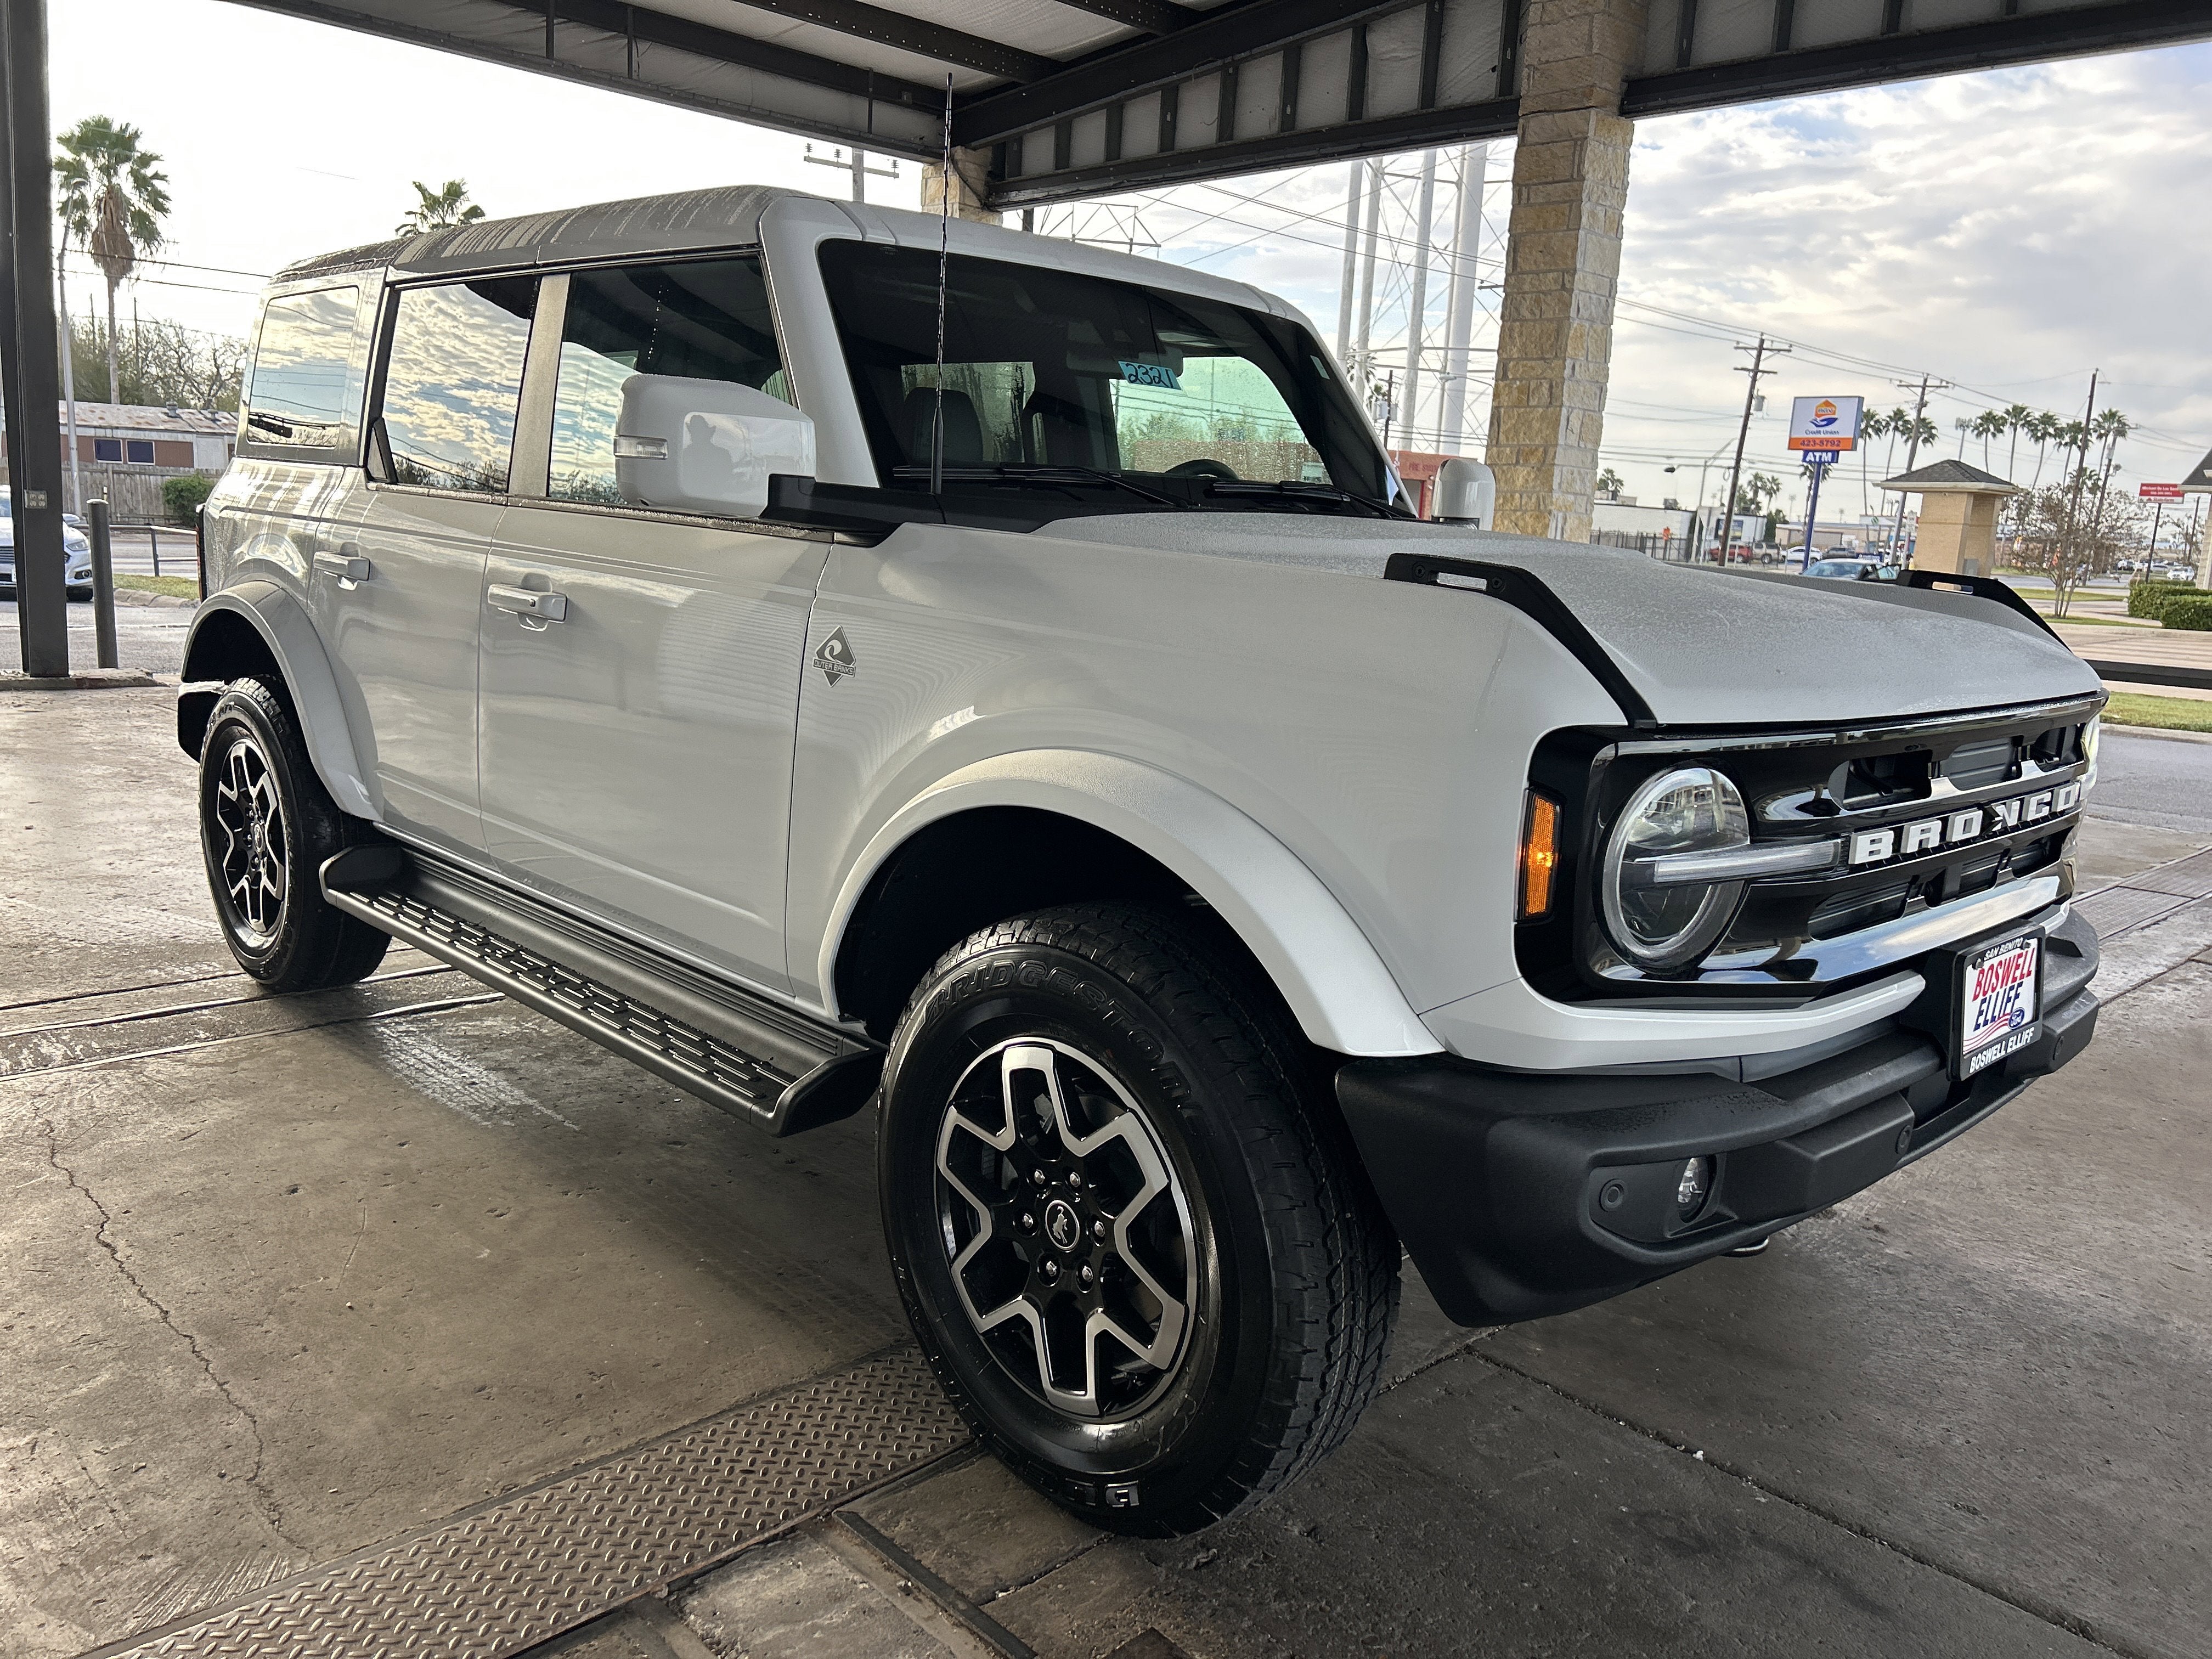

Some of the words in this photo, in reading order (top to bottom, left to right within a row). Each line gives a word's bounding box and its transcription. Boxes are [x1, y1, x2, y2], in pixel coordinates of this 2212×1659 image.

[1125, 363, 1175, 388] 2321
[1805, 452, 1832, 462] ATM
[814, 659, 833, 670] OUTER
[833, 664, 854, 675] BANKS
[1849, 783, 2079, 865] BRONCO
[1983, 946, 2000, 961] SAN
[2000, 937, 2023, 956] BENITO
[1972, 947, 2035, 1002] BOSWELL
[1973, 981, 2024, 1032] ELLIFF
[1969, 1044, 2006, 1074] BOSWELL
[2007, 1026, 2035, 1053] ELLIFF
